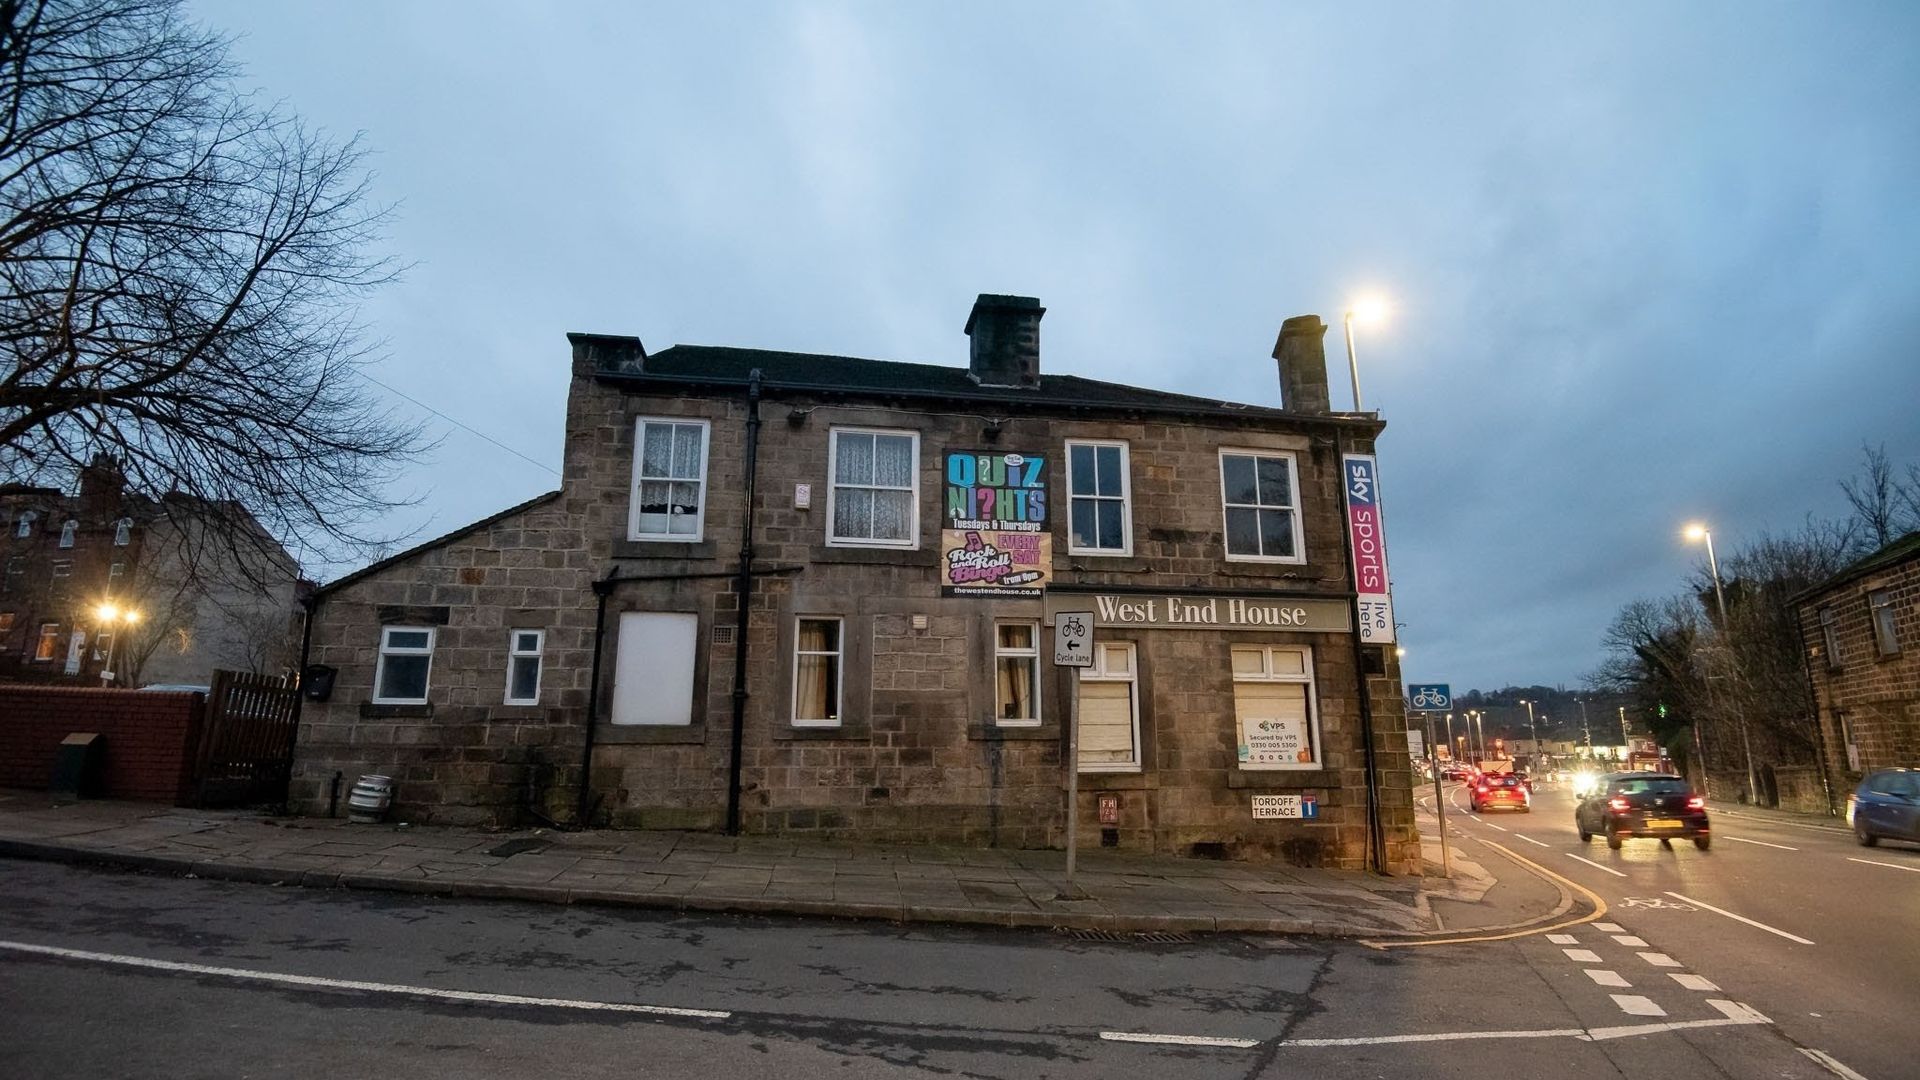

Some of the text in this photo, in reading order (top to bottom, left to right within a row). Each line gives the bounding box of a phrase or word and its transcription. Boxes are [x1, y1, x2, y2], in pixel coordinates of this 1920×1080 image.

[953, 519, 1041, 532] Tuesdays & Thursdays
[1351, 465, 1380, 588] sky sports
[998, 534, 1041, 549] EVERY
[949, 545, 996, 562] Rock
[951, 553, 1010, 569] and Roll
[1012, 550, 1041, 565] SAT
[950, 565, 1011, 582] Bingo
[1003, 575, 1021, 585] from
[954, 587, 1041, 596] thewestendhouse.co.uk
[1095, 595, 1307, 626] West End House
[1374, 601, 1387, 629] live
[1359, 601, 1372, 639] here
[1056, 653, 1073, 663] Cycle
[1270, 722, 1286, 730] VPS
[1253, 797, 1294, 806] TORDOFF
[1253, 807, 1296, 816] TERRACE
